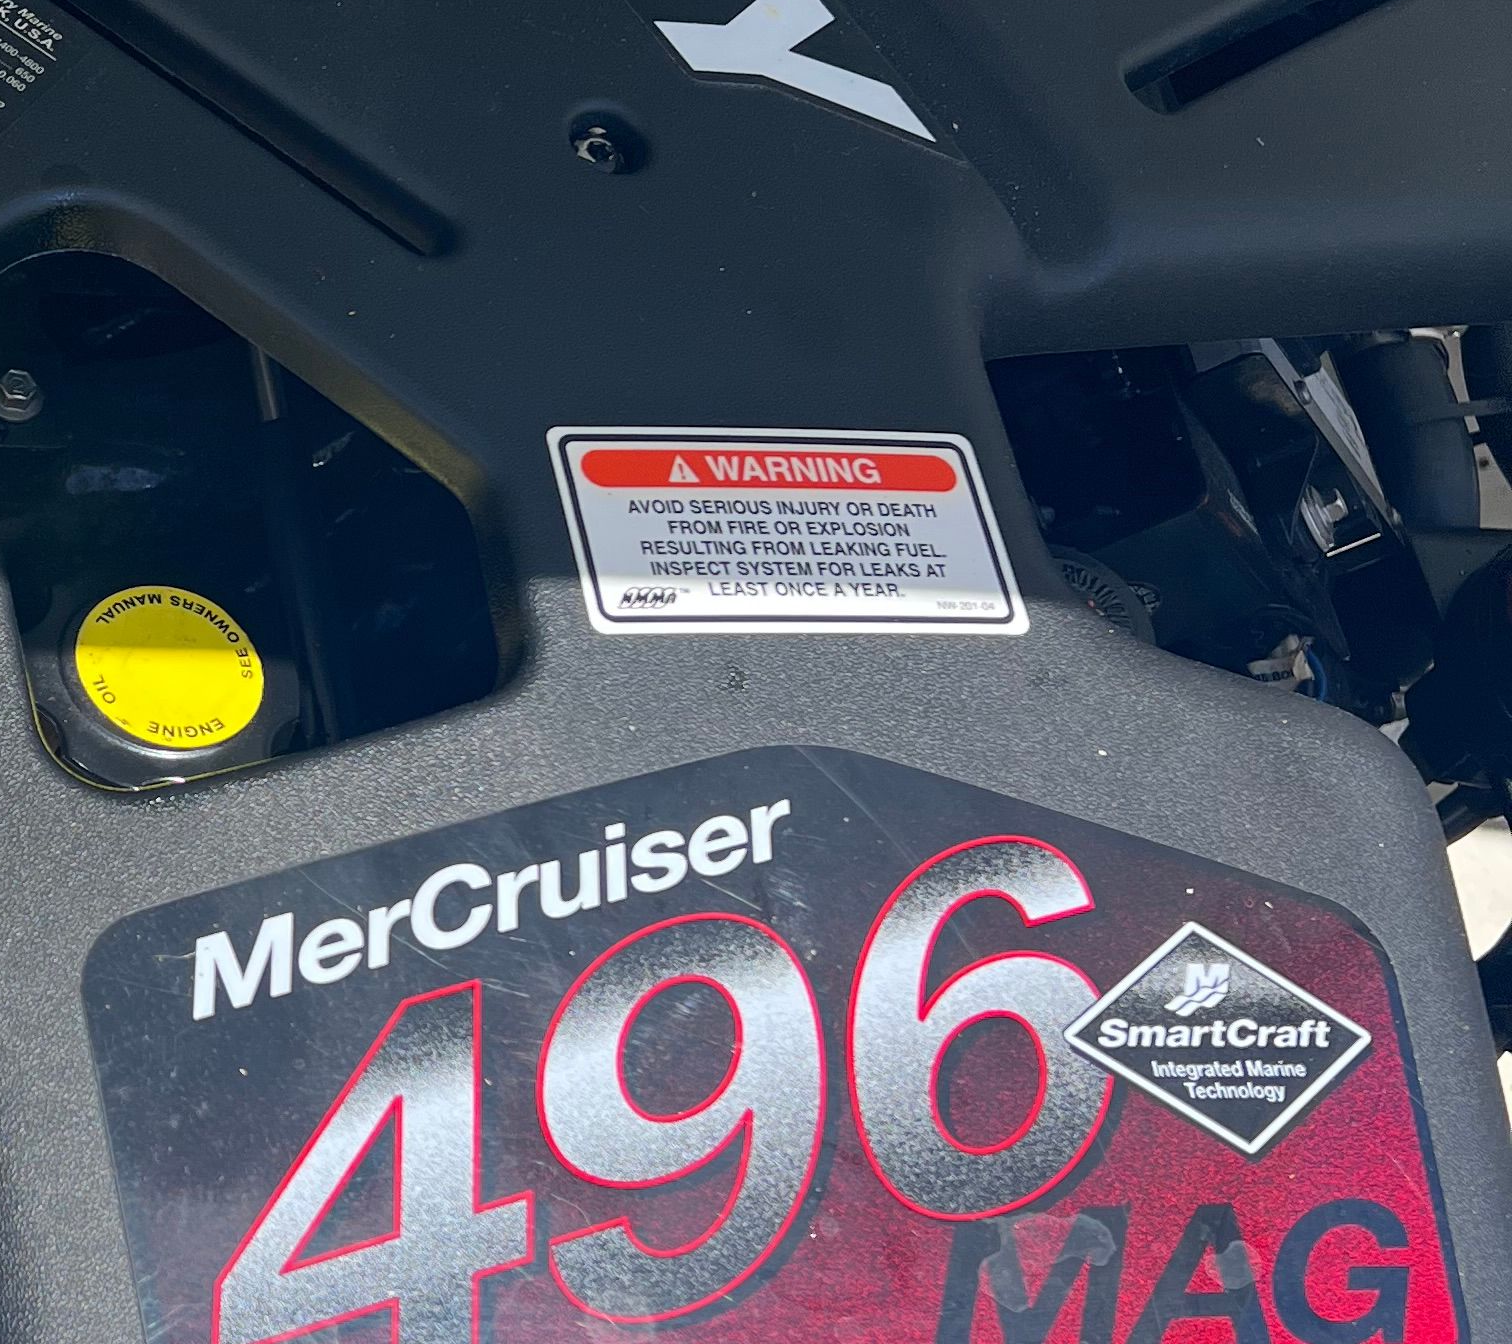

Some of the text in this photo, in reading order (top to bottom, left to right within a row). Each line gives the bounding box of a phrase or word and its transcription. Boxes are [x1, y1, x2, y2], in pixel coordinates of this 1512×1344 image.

[18, 8, 63, 41] Marine
[15, 67, 36, 83] 650
[704, 455, 882, 484] WARNING
[627, 499, 937, 518] AVOID SERIOUS INJURY OR DEATH
[668, 521, 910, 537] FROM FIRE OR EXPLOSION
[641, 541, 946, 558] RESULTING FROM LEAKING FUEL.
[651, 561, 947, 578] INSPECT SYSTEM FOR LEAKS AT
[708, 581, 905, 598] LEAST ONCE A YEAR.
[95, 593, 253, 679] SEE OWNERS MANUAL
[92, 675, 225, 738] ENGINE OIL
[192, 798, 792, 1022] MerCruiser
[1098, 1019, 1331, 1047] SmartCraft
[1151, 1061, 1306, 1078] Integrated Marine
[1184, 1082, 1286, 1102] Technology
